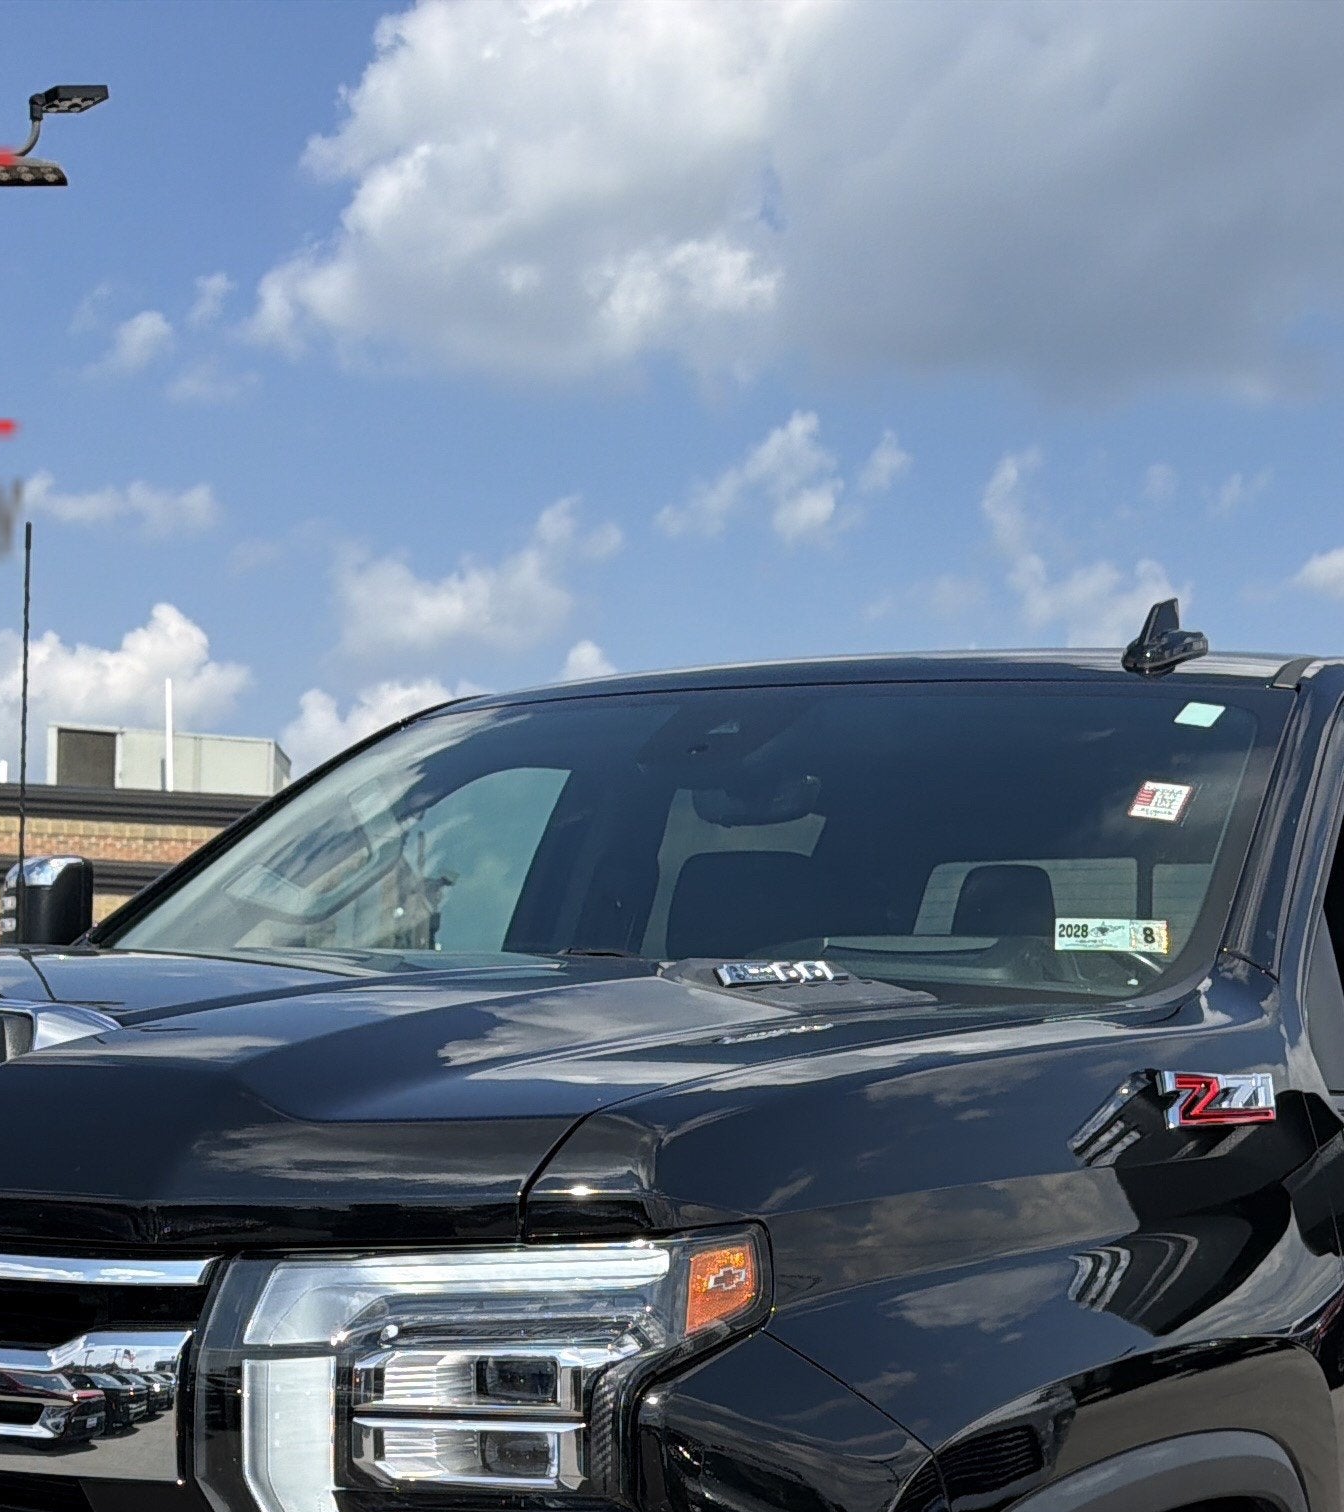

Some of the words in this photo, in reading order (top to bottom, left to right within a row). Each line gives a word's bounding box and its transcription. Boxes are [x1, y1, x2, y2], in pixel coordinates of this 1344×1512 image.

[1058, 923, 1089, 938] 2028
[1142, 926, 1156, 944] 8
[1162, 1070, 1276, 1129] Z71
